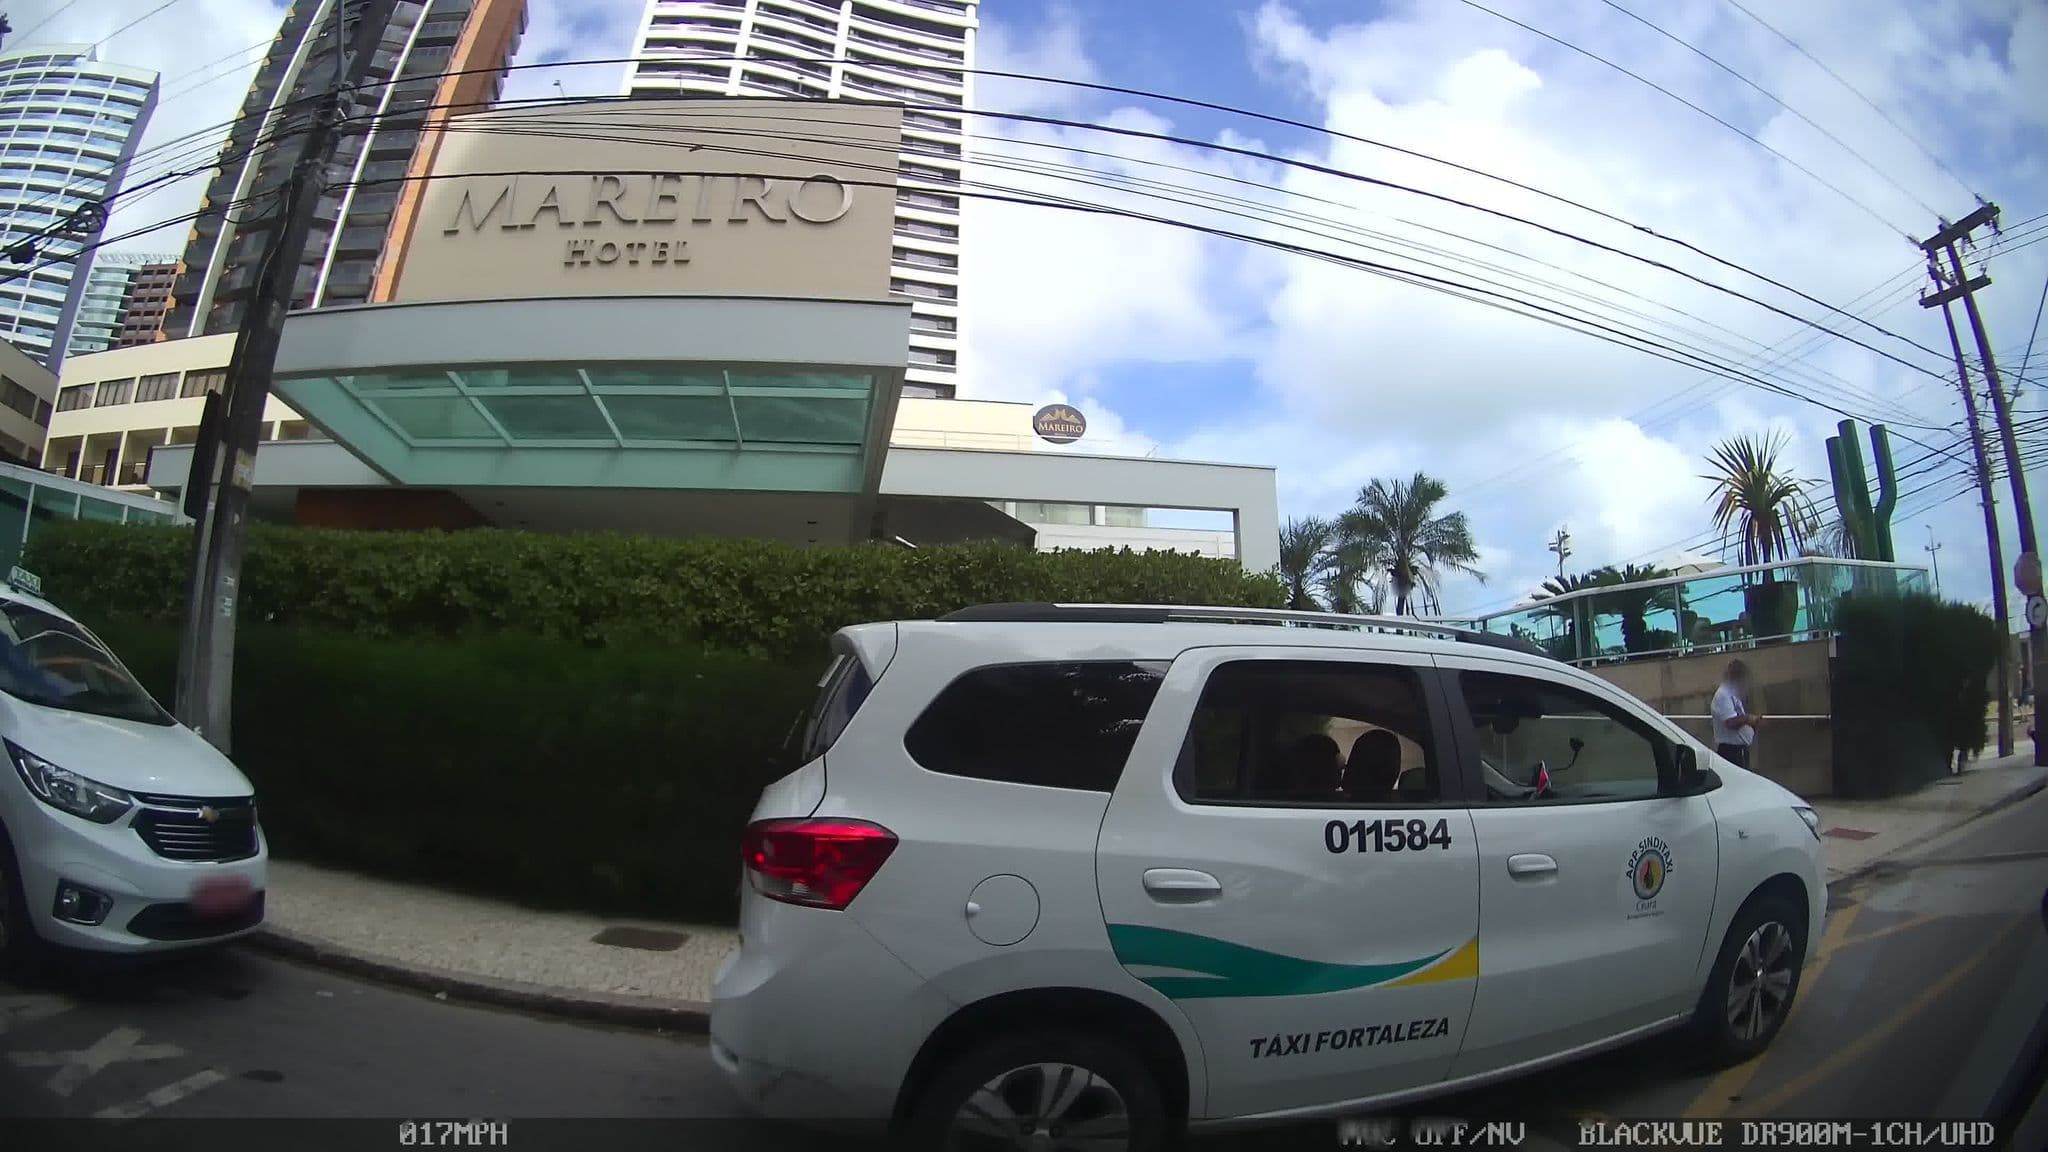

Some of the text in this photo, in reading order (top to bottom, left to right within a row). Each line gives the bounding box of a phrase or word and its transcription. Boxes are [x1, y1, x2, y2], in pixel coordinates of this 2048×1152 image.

[443, 174, 854, 235] MAREIRO
[564, 240, 691, 268] HOTEL
[1039, 422, 1084, 433] MAREIRO
[1325, 818, 1452, 854] 011584
[1626, 836, 1674, 879] APP SINDITAXI
[1315, 1017, 1449, 1052] FORTALEZA
